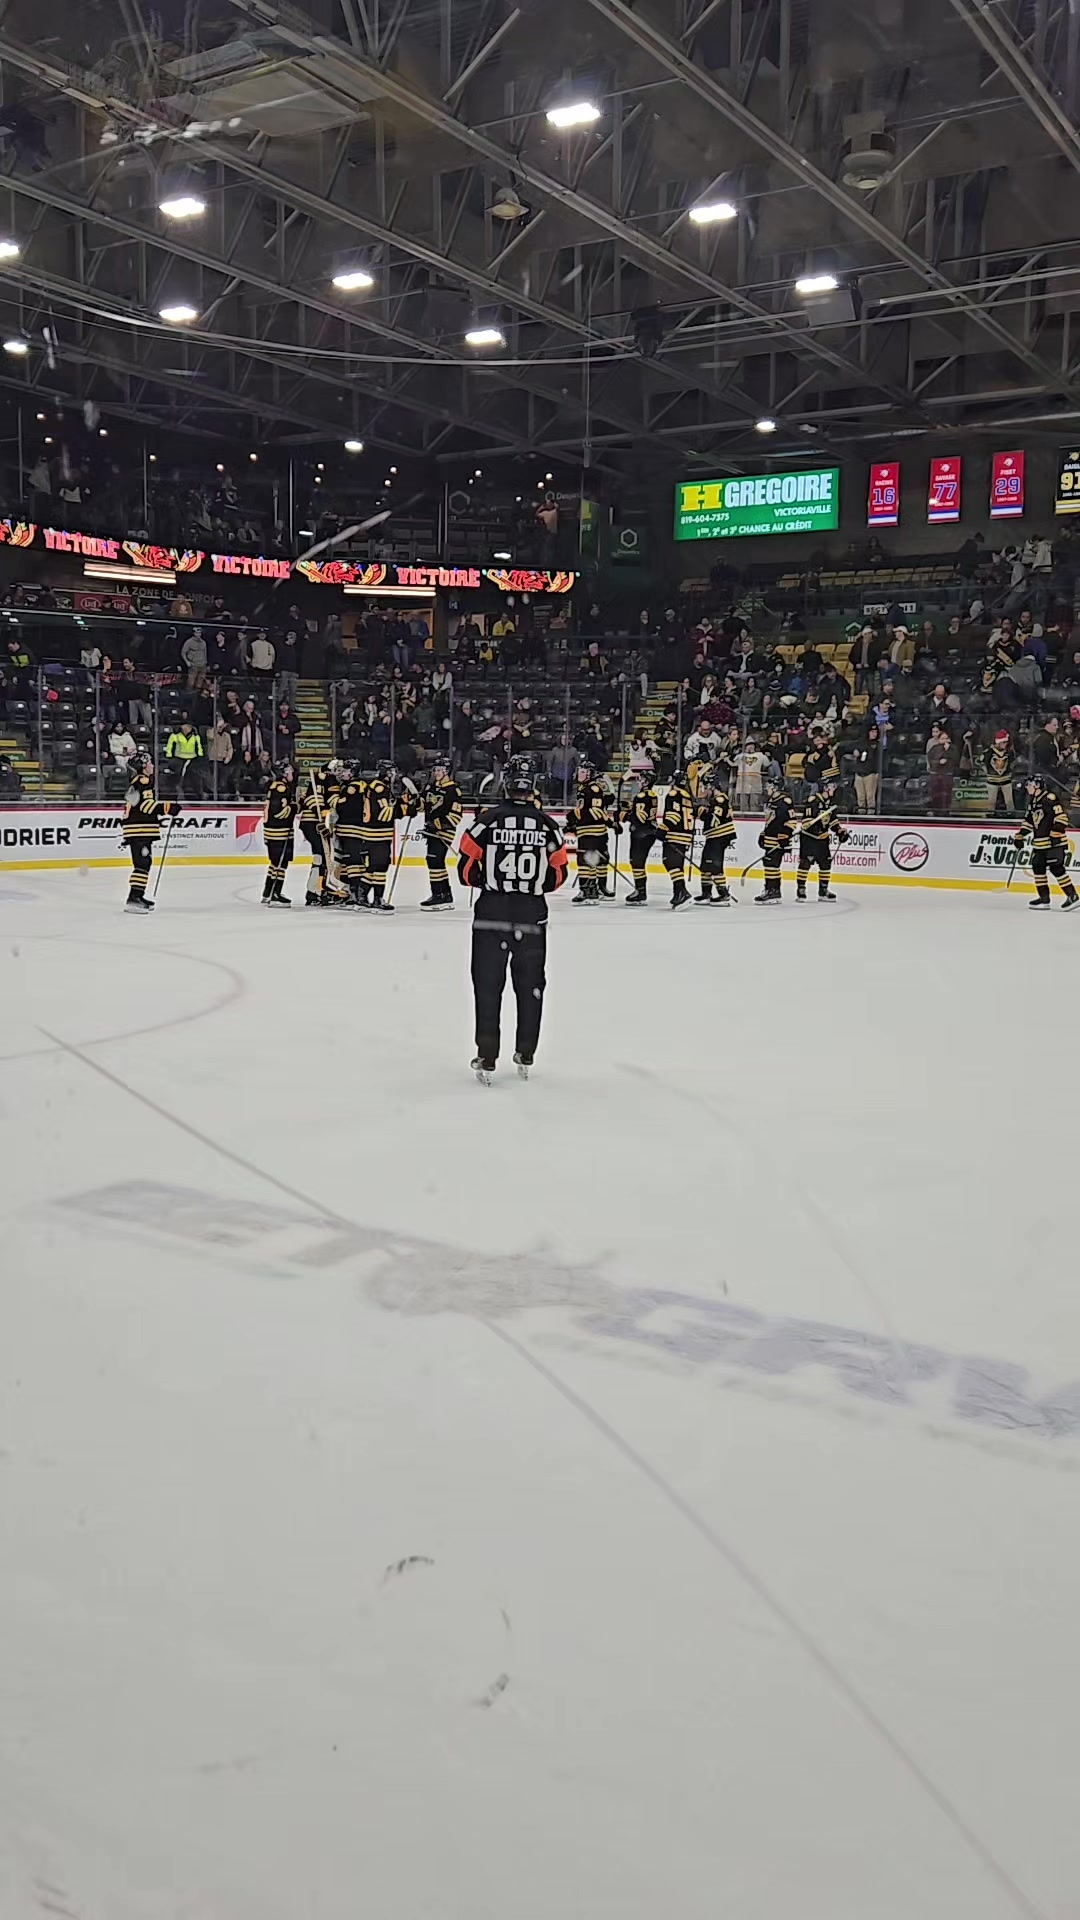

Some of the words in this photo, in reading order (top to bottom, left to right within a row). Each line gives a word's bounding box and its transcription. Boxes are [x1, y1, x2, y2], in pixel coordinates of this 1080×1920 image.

[681, 483, 723, 511] H
[724, 473, 833, 508] GREGOIRE
[872, 487, 895, 505] 16
[933, 482, 957, 501] 77
[994, 477, 1020, 496] 29
[774, 505, 831, 517] VICTORIAVILLE
[738, 523, 771, 535] CHANCE
[771, 522, 784, 531] AU
[785, 520, 812, 531] CRÉDIT
[43, 528, 120, 559] VICTOIRE
[211, 554, 291, 579] VICTOIRE
[396, 567, 481, 588] VICTOIRE
[116, 584, 130, 595] LA
[0, 827, 71, 846] DRIER
[493, 829, 546, 846] COMTOIS
[847, 830, 879, 850] Souper
[499, 852, 536, 880] 40
